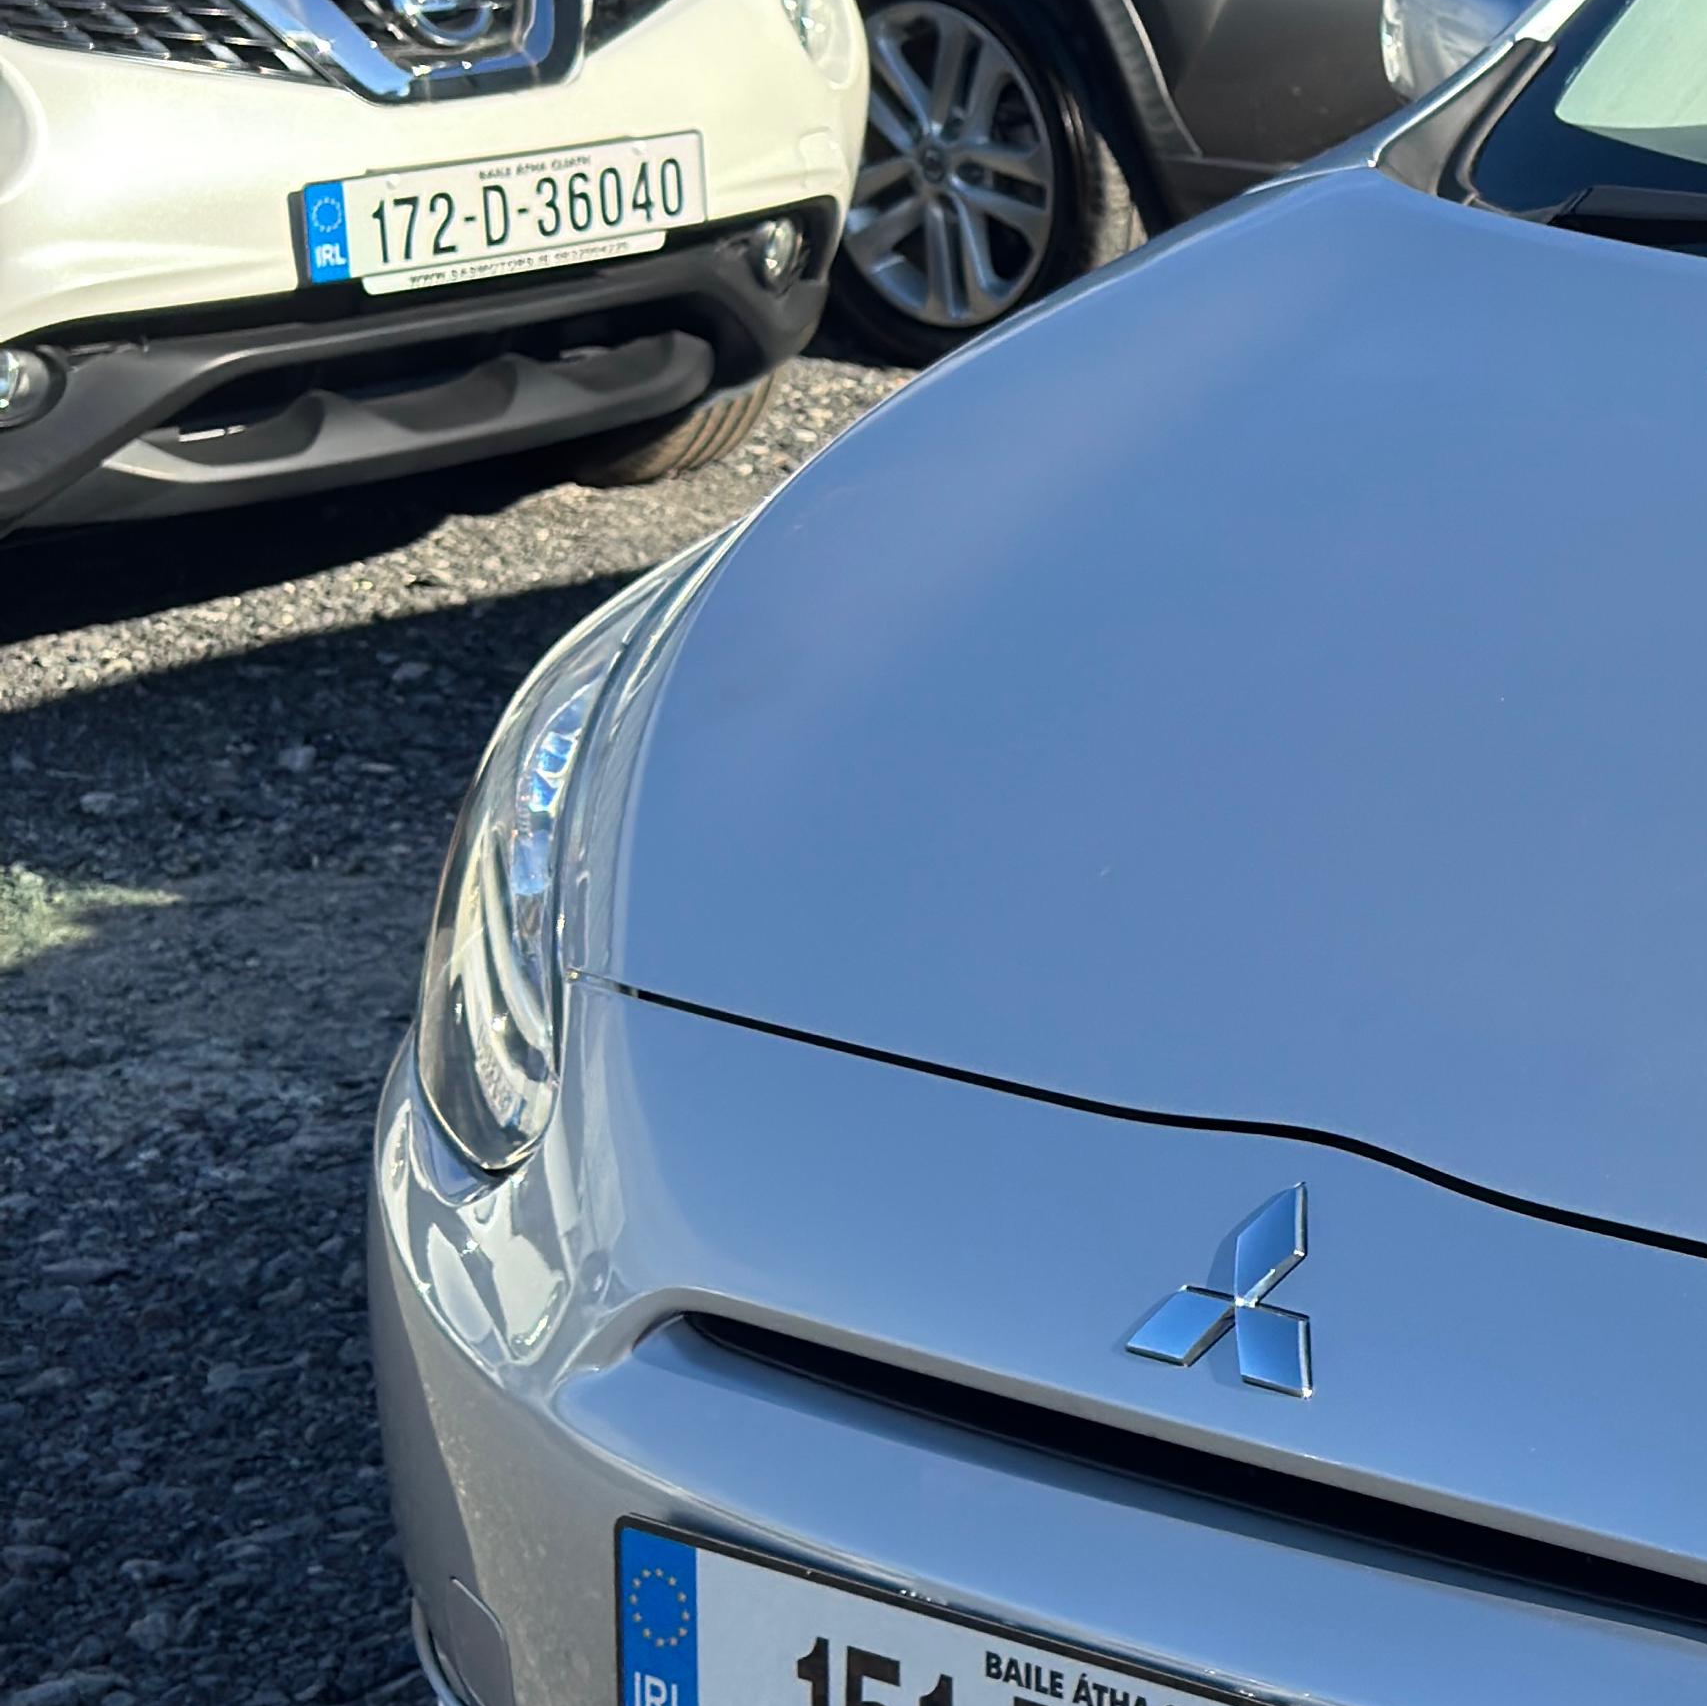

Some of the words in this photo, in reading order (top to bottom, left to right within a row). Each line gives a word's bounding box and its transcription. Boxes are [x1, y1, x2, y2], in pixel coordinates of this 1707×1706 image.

[372, 158, 683, 264] 172-D-36040
[316, 243, 346, 268] IRL
[985, 1650, 1064, 1701] BAILE
